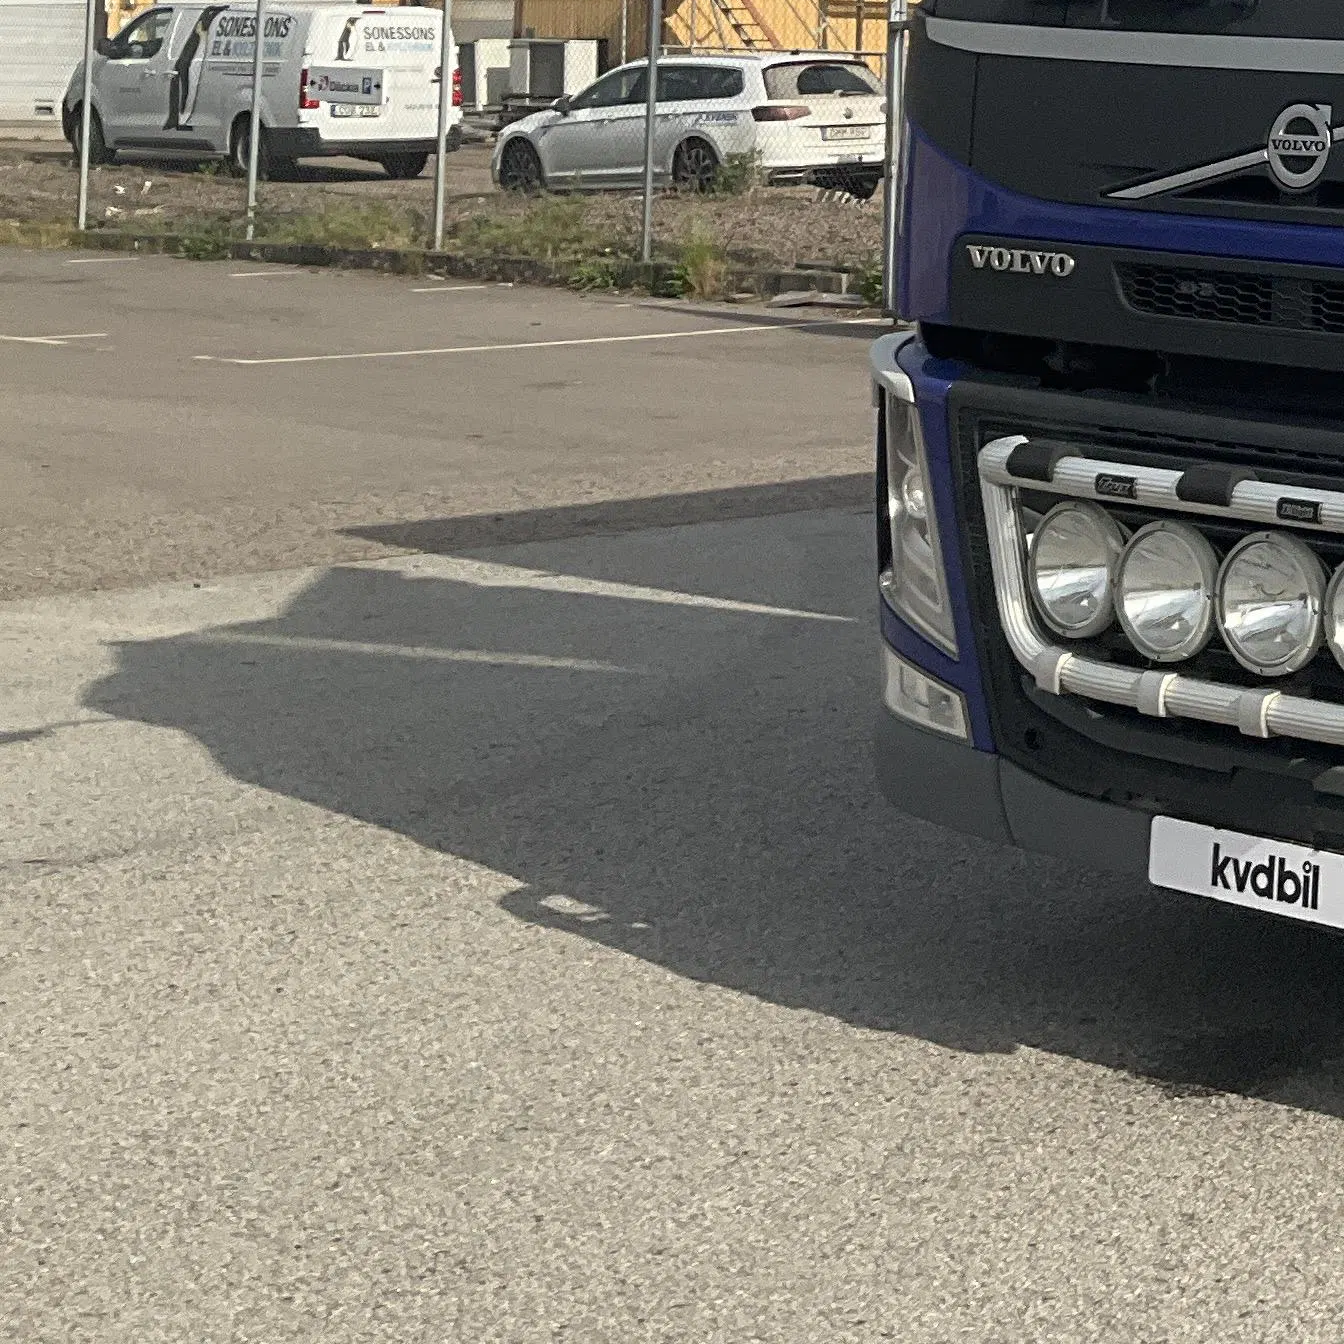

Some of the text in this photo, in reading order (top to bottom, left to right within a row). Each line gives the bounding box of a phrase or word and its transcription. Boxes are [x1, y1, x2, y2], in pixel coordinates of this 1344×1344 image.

[216, 16, 290, 38] SONESONS
[363, 26, 436, 40] SONESSONS
[1271, 139, 1326, 152] VOLVO
[966, 244, 1075, 277] VOLVO
[1211, 842, 1320, 910] kvdbil
